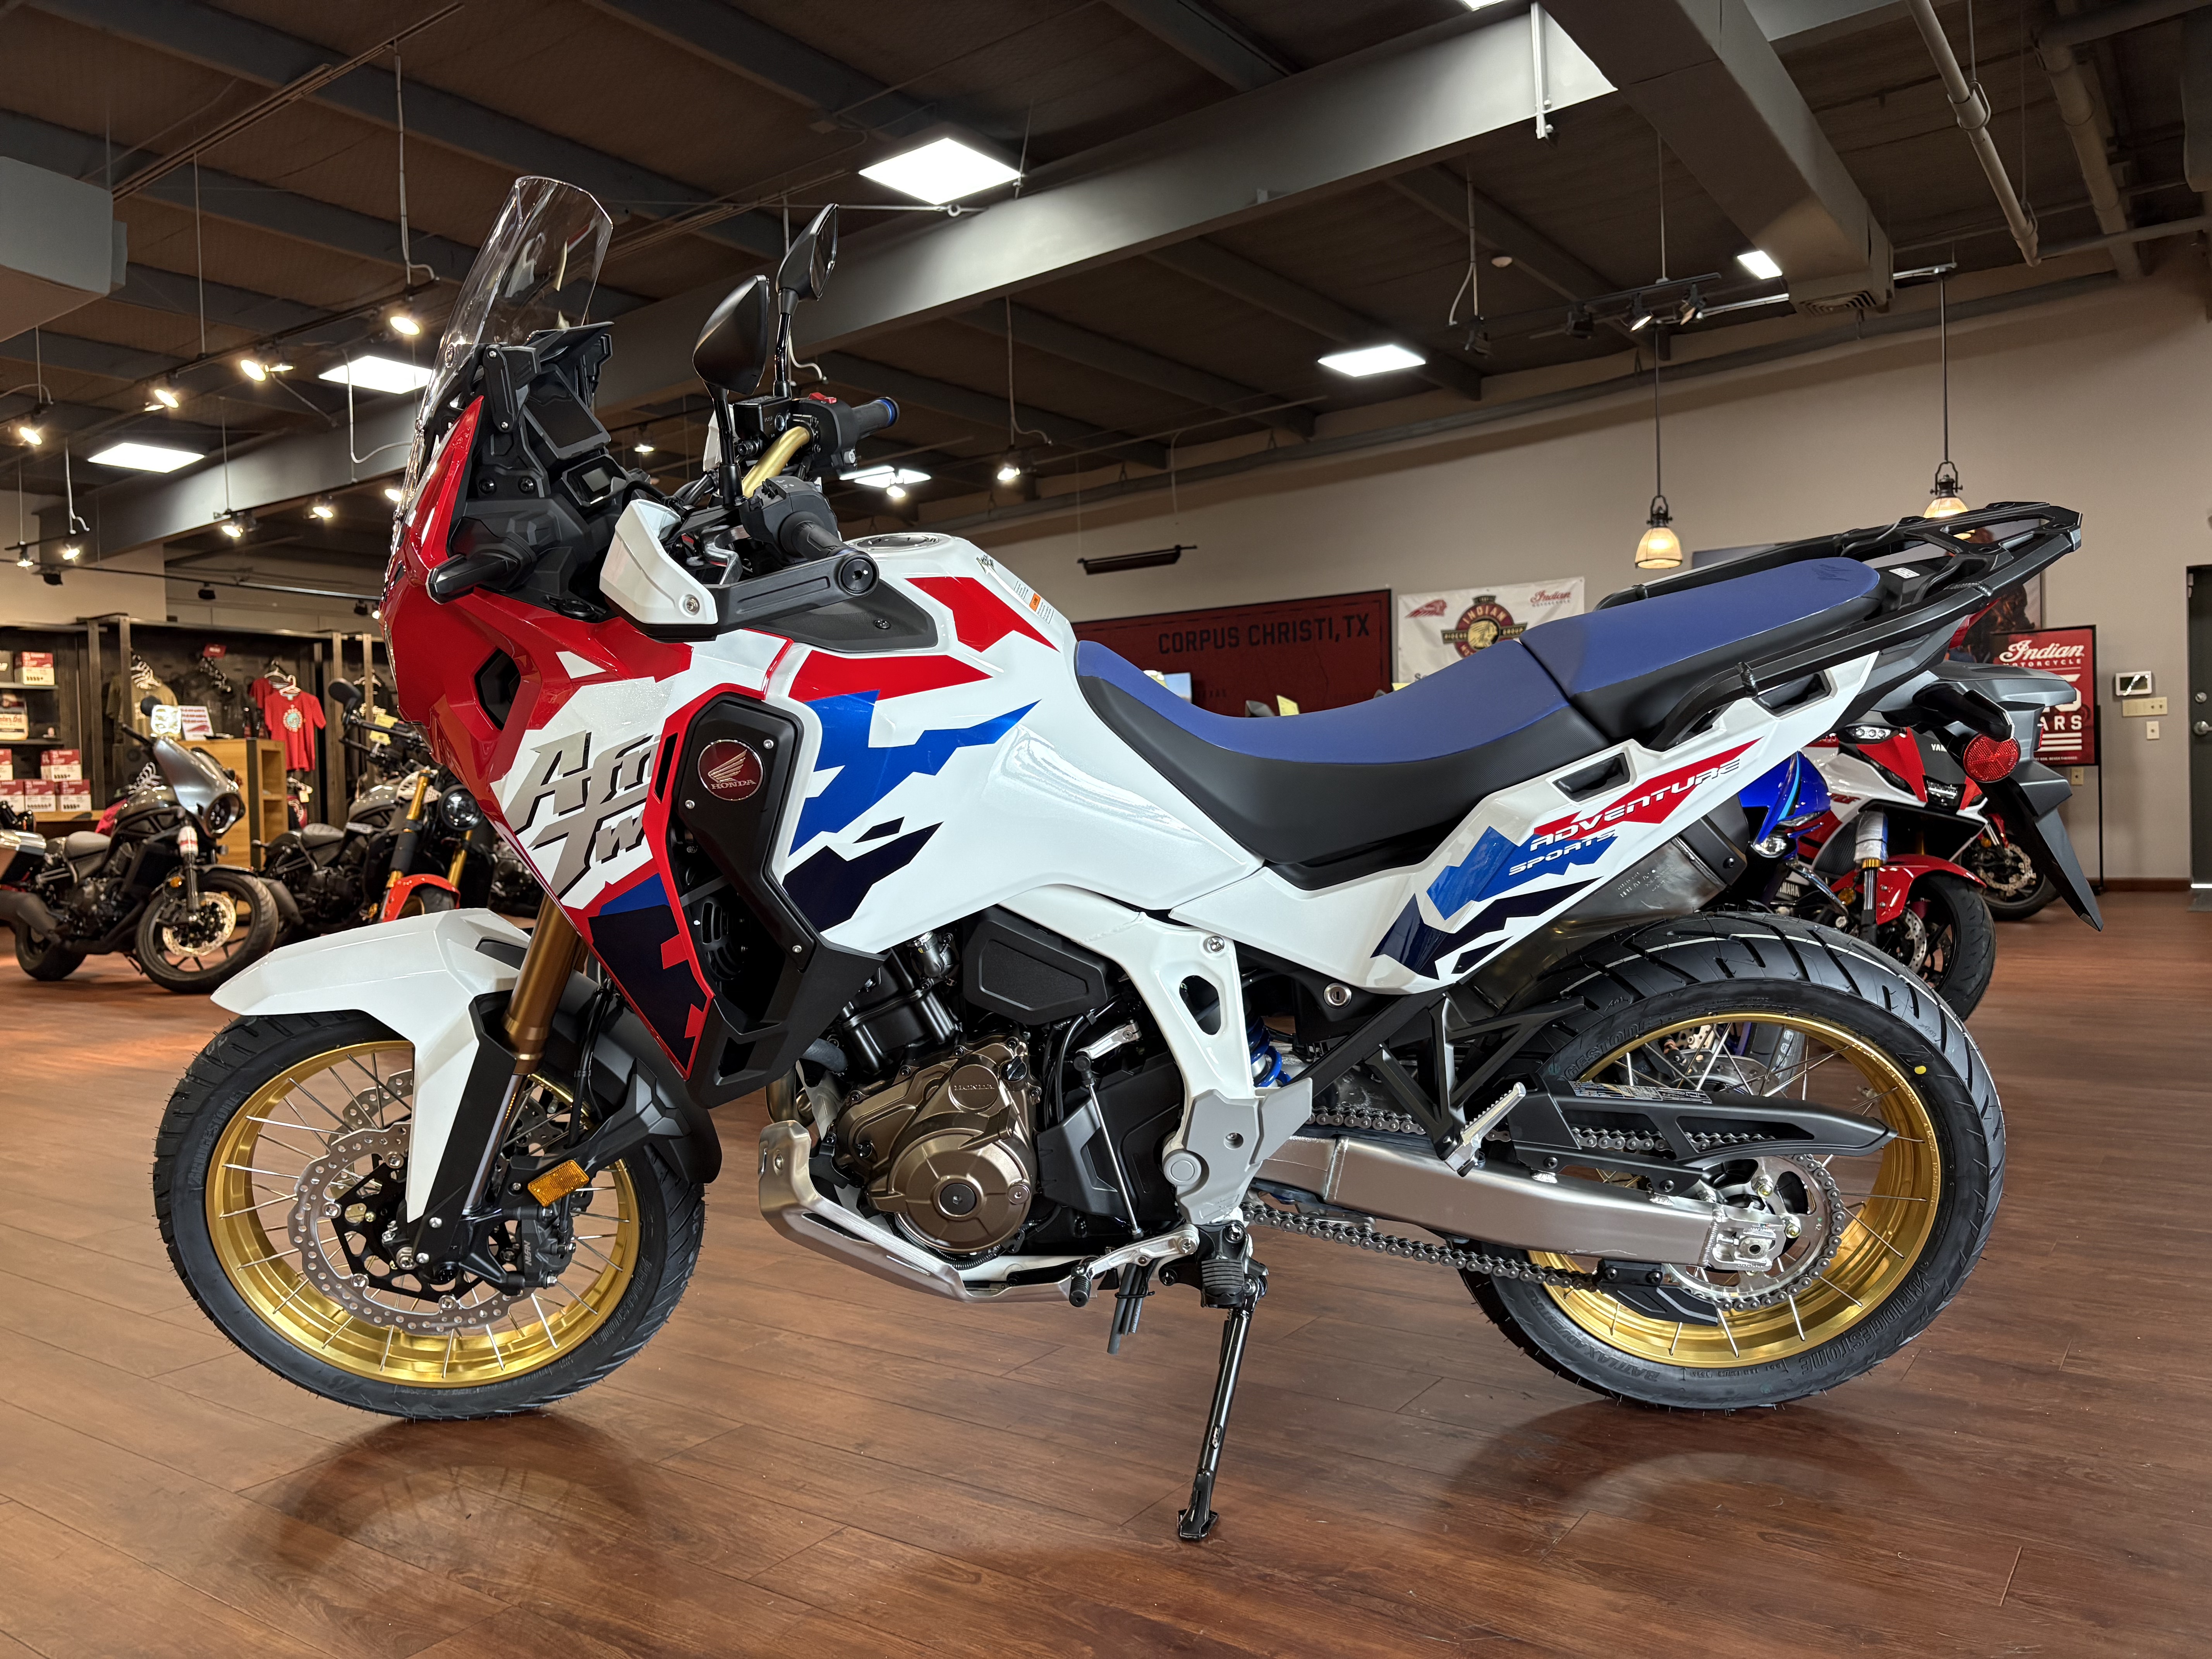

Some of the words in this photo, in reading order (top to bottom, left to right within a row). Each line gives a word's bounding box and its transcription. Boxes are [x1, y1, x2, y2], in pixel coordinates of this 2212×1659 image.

[1463, 605, 1506, 624] INDIAN
[1159, 626, 1240, 654] CORPUS
[1999, 640, 2084, 662] Indian
[2040, 715, 2082, 731] ARS
[711, 779, 757, 789] HONDA
[1530, 758, 1740, 852] ADVENTURE
[1508, 828, 1619, 876] SPORTS
[1779, 882, 1800, 898] MAHA
[1799, 1273, 1931, 1376] BRIDGESTONE
